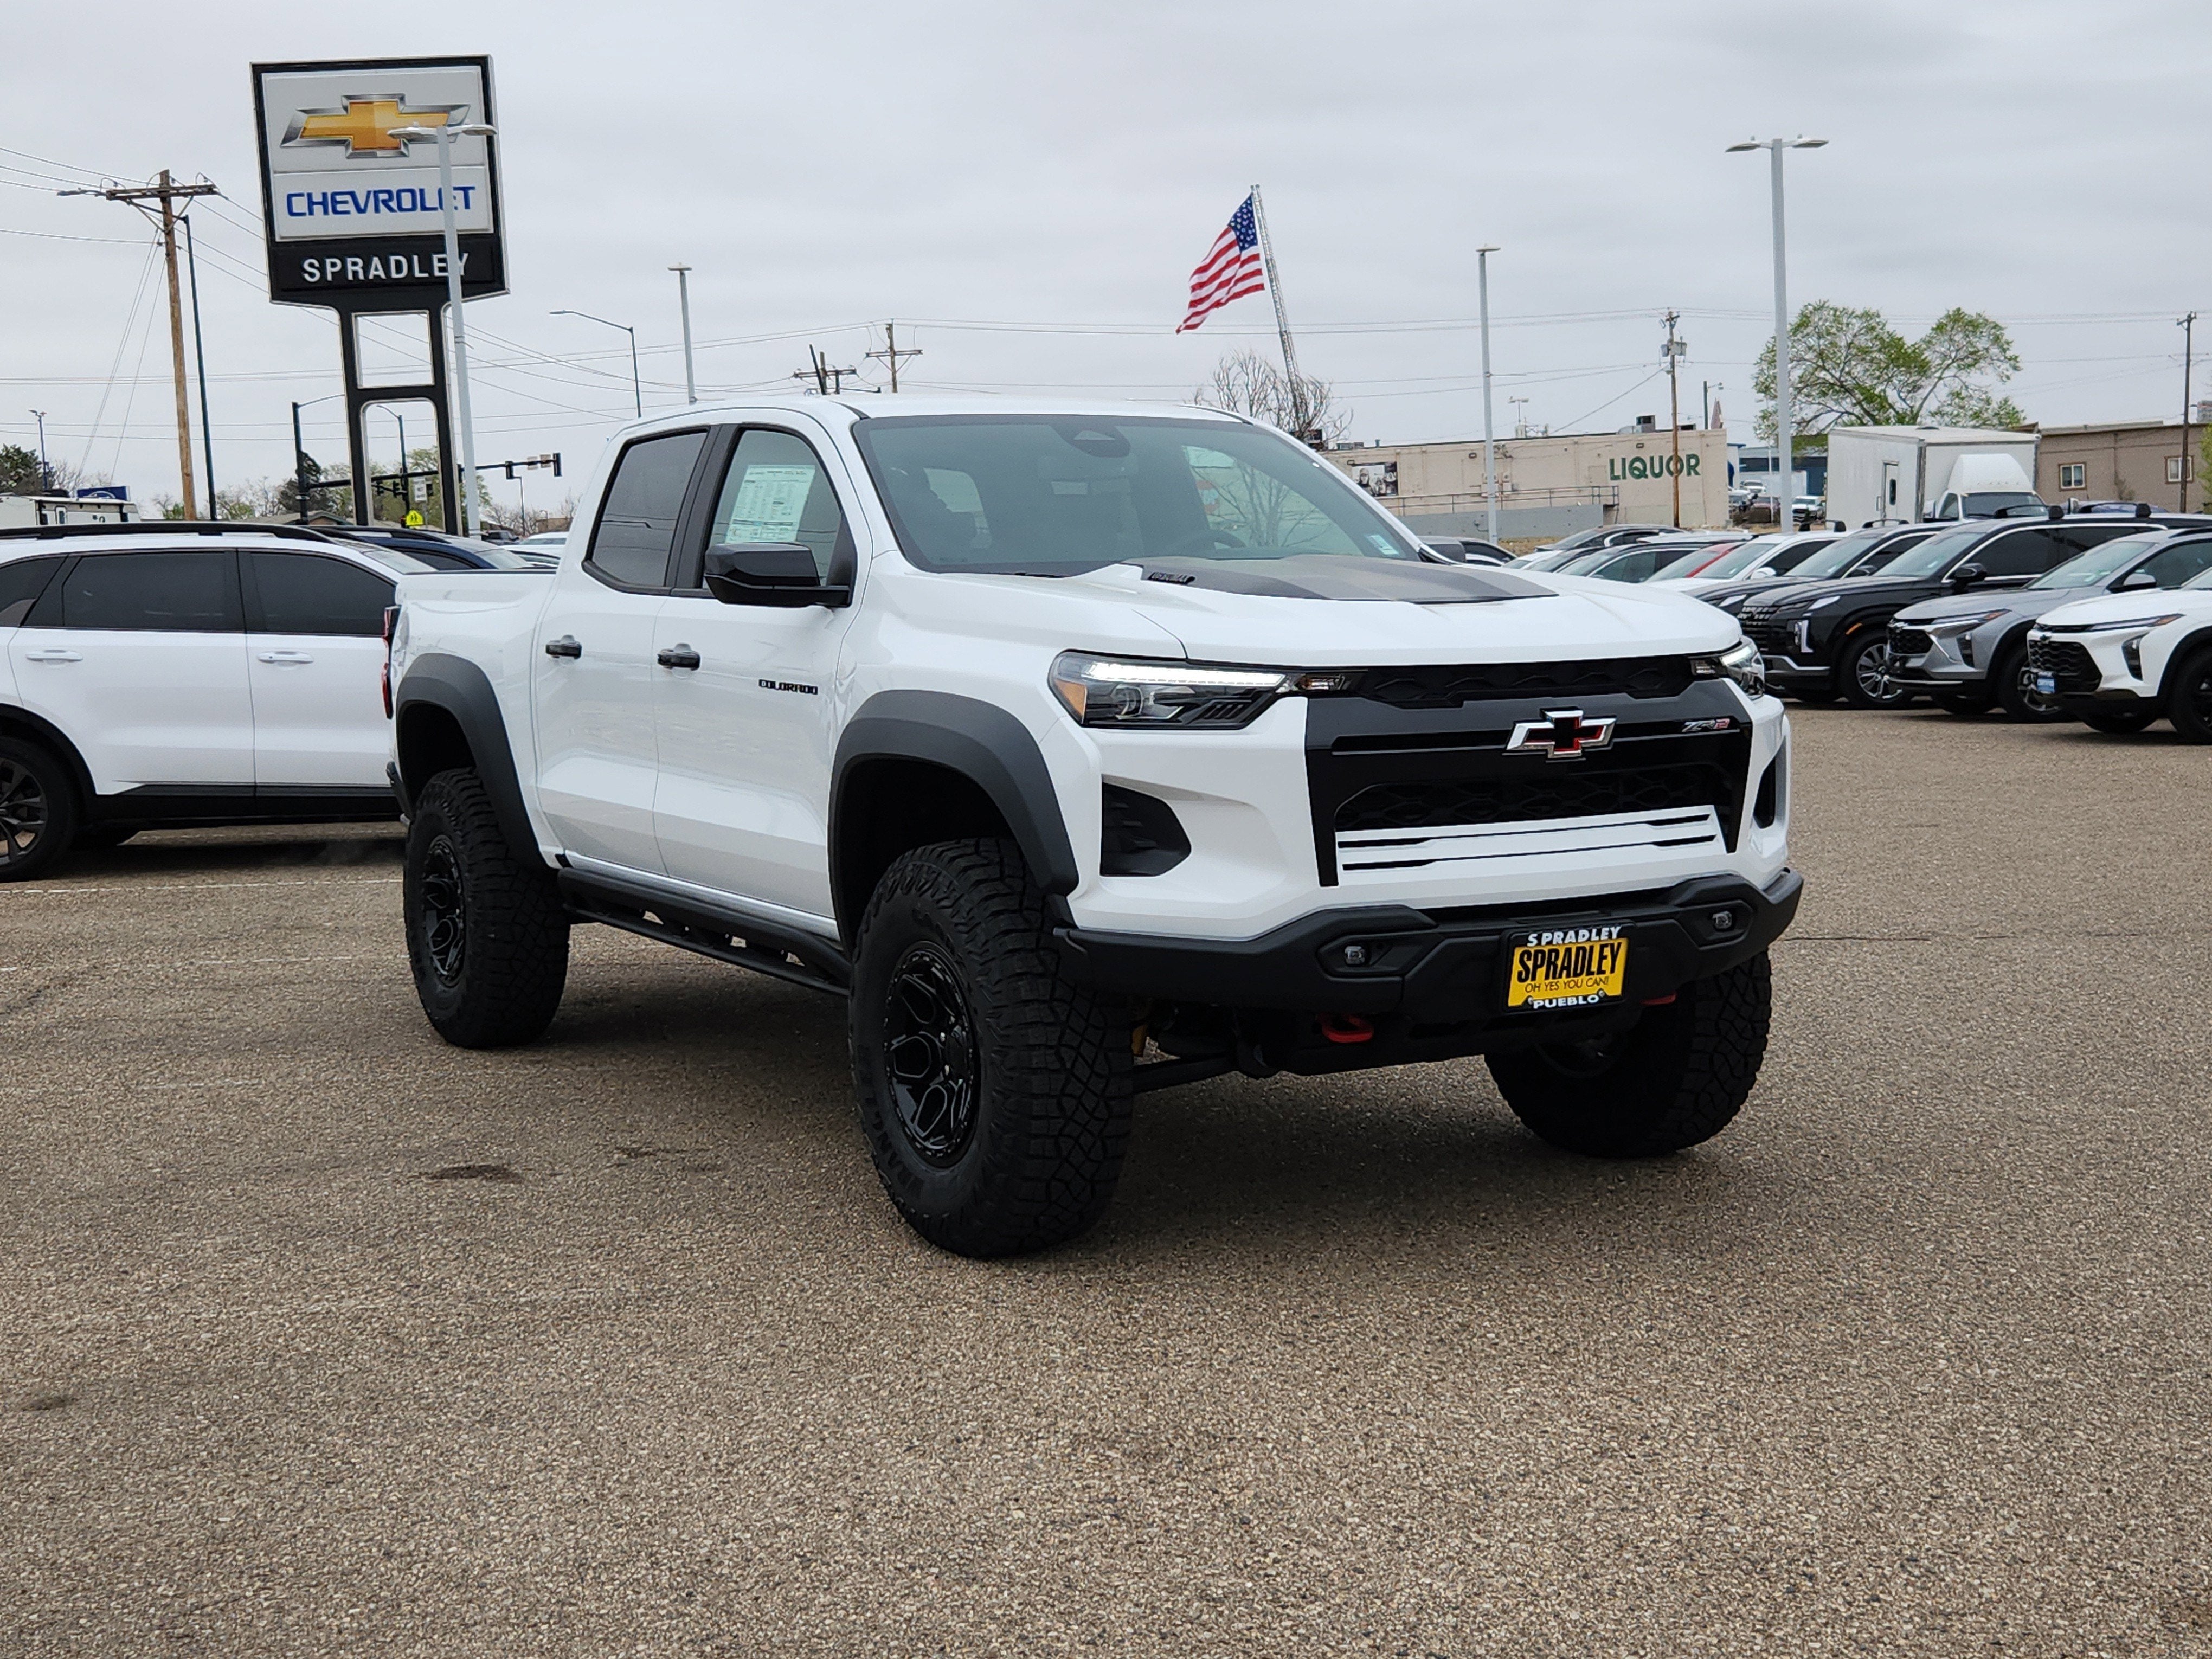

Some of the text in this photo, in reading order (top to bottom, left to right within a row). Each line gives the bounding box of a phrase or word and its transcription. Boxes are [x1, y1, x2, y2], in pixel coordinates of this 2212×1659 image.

[303, 253, 468, 282] SPRADLEY
[1609, 454, 1701, 480] LIQUOR
[1681, 718, 1731, 733] ZR2
[1527, 926, 1622, 947] SPRADLEY
[1517, 942, 1622, 983] SPRADLEY
[1525, 983, 1541, 993] OH
[1544, 980, 1560, 992] YES
[1563, 978, 1584, 989] YOU
[1533, 994, 1599, 1009] PUEBLO
